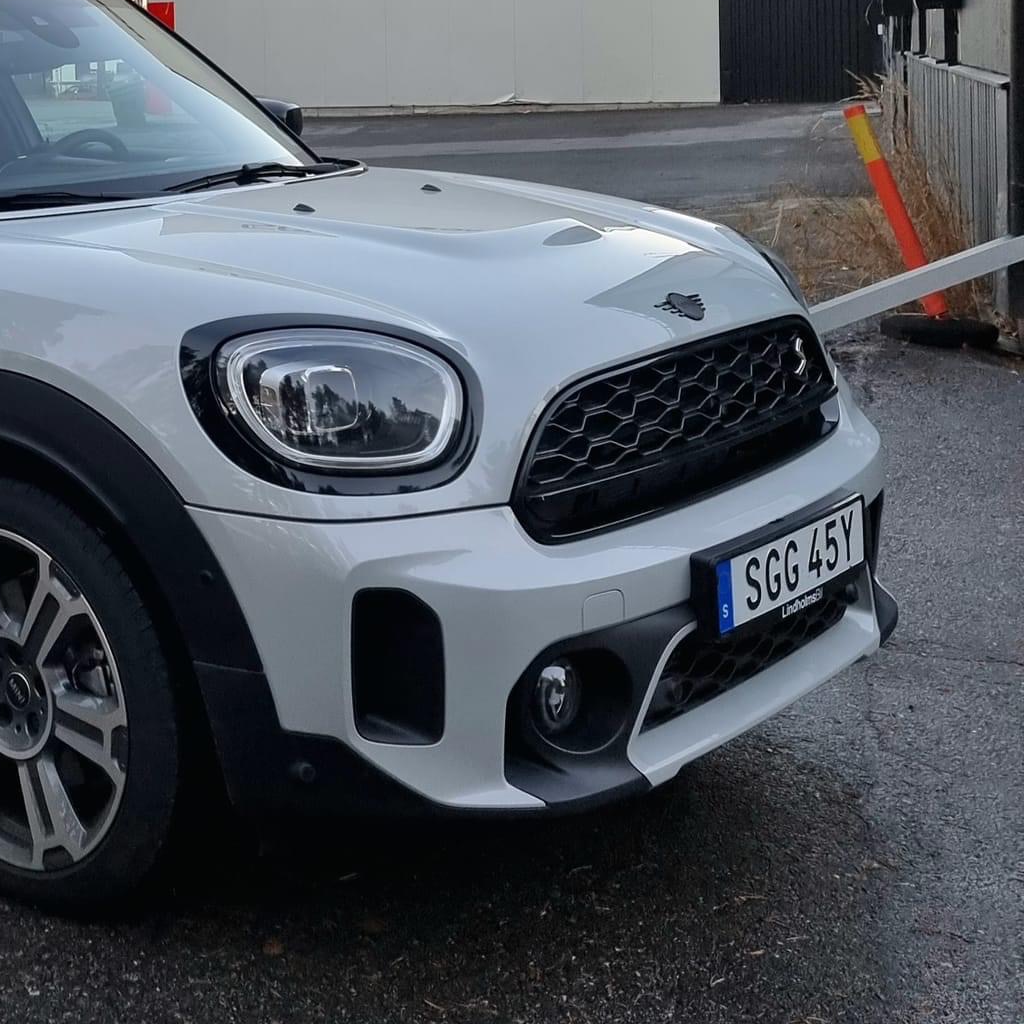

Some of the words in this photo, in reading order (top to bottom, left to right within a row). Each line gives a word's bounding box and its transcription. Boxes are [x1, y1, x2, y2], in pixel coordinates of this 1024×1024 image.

[745, 539, 800, 611] SGG
[808, 509, 854, 578] 45Y
[722, 603, 729, 619] S
